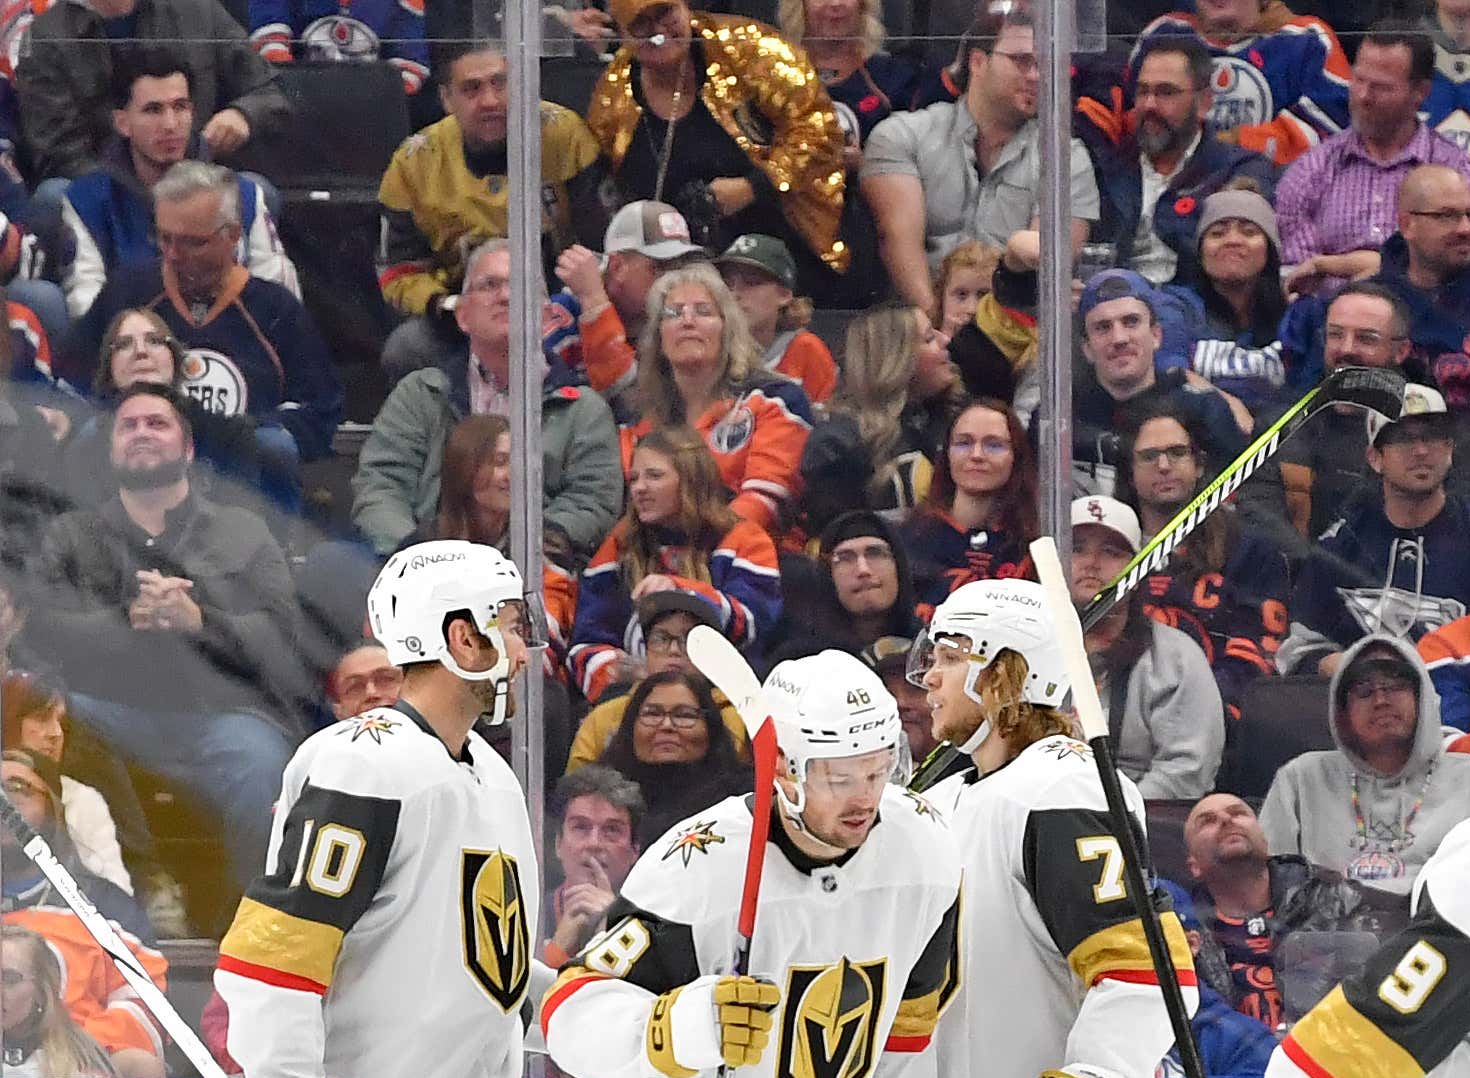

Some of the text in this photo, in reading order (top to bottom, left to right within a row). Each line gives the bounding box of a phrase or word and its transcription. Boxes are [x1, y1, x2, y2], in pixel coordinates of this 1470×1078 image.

[1192, 573, 1224, 609] C
[849, 718, 885, 734] CCM
[289, 819, 367, 899] 10
[1075, 835, 1128, 905] 7
[580, 915, 651, 979] 8
[1377, 939, 1448, 1015] 9
[652, 989, 672, 1051] CC
